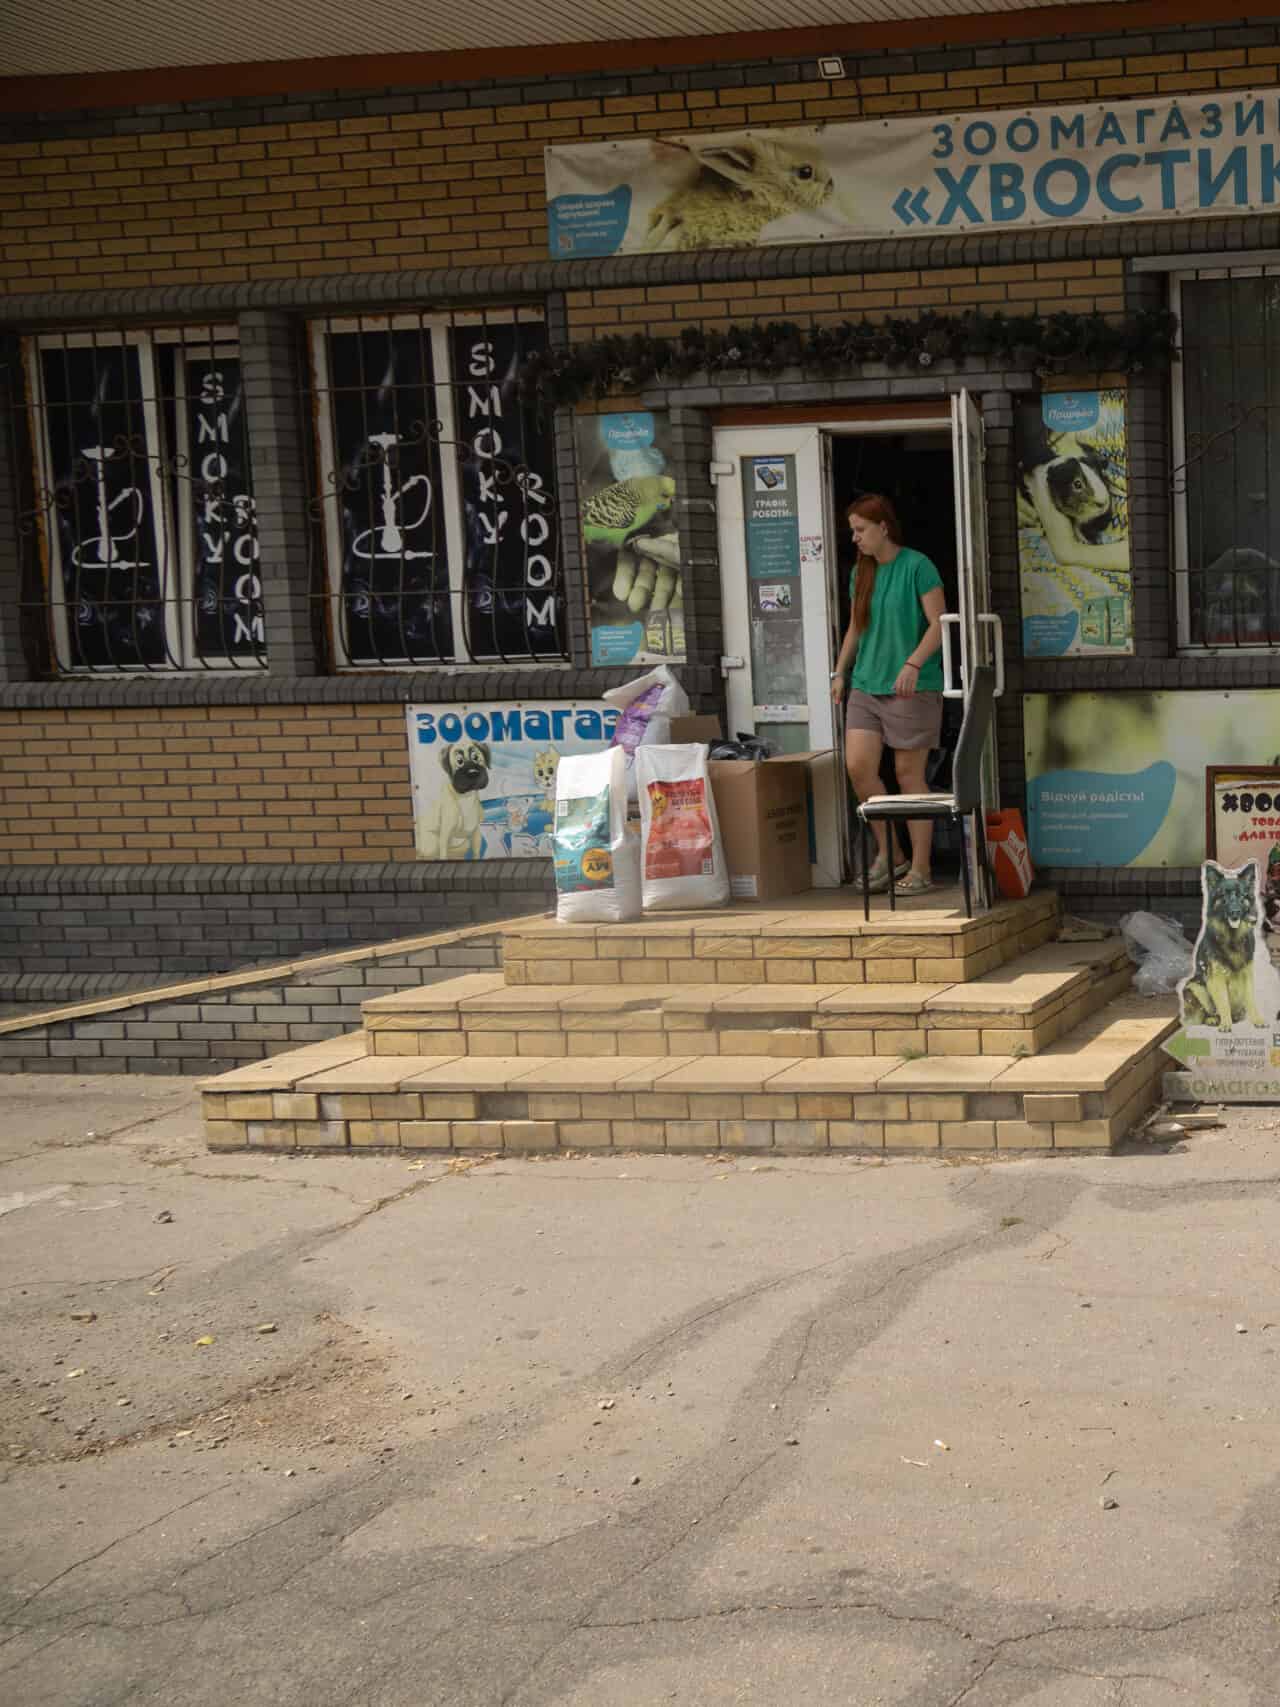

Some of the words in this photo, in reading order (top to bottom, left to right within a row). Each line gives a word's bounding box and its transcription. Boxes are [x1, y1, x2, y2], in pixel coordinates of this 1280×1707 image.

[197, 371, 230, 564] SMOKY
[468, 341, 508, 544] SMOKY
[231, 494, 265, 643] ROOM
[518, 471, 556, 627] ROOM
